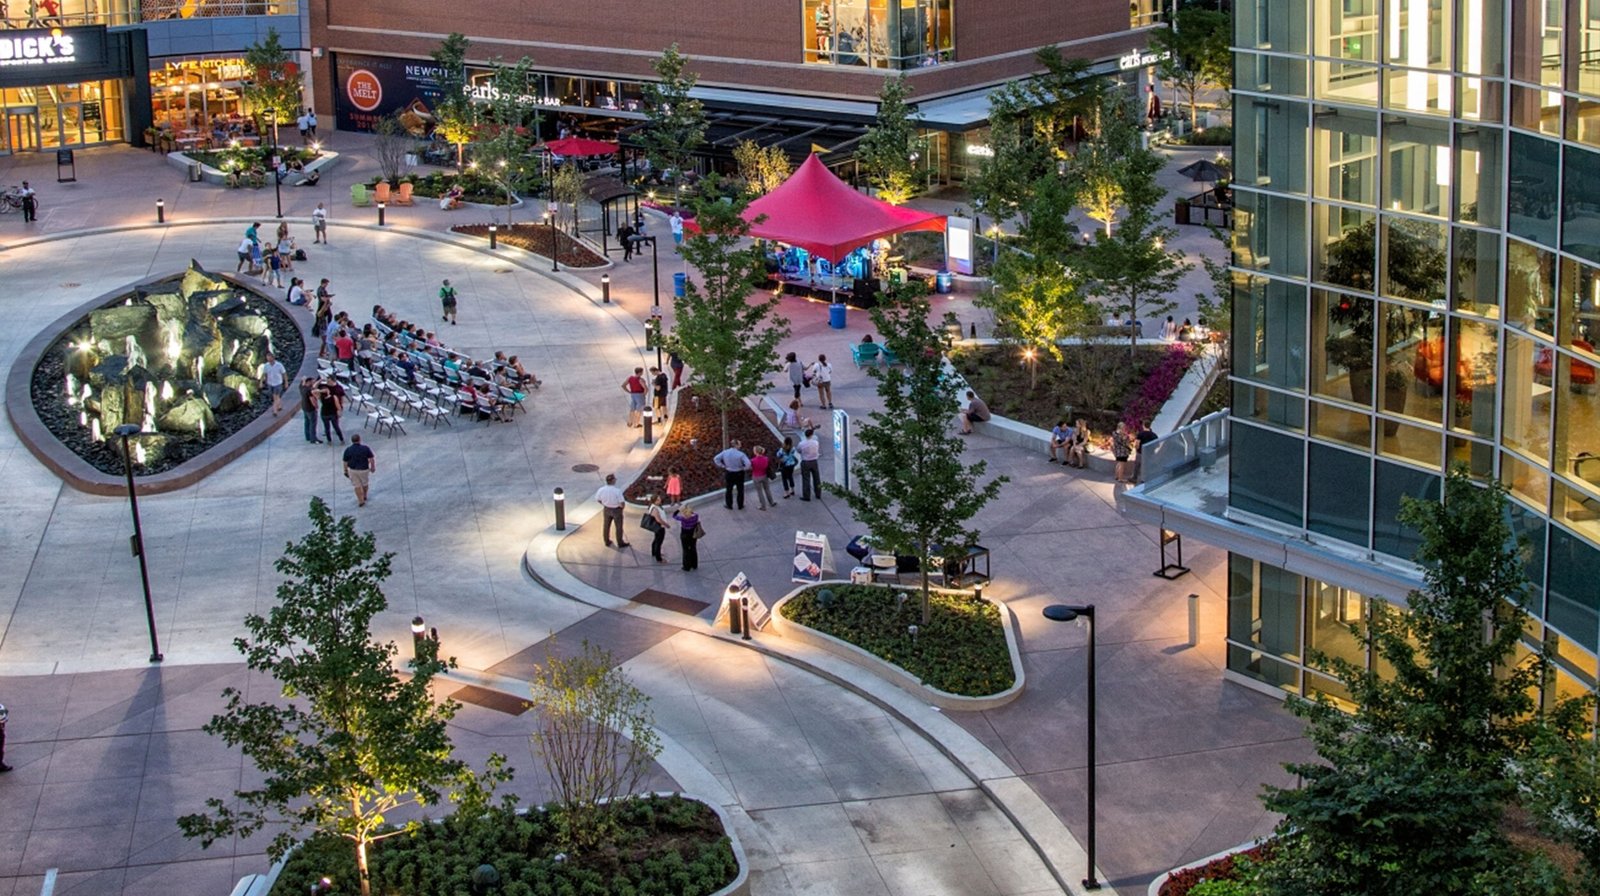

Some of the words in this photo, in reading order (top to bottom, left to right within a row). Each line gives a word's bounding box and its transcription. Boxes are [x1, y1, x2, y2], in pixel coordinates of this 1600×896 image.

[0, 31, 75, 59] DICK'S
[166, 61, 198, 71] LYFE
[200, 58, 245, 68] KITCHEN
[405, 65, 457, 79] NEWCIT
[357, 81, 372, 90] THE
[353, 88, 377, 100] MELT
[463, 81, 500, 100] earls
[544, 97, 561, 107] BAR
